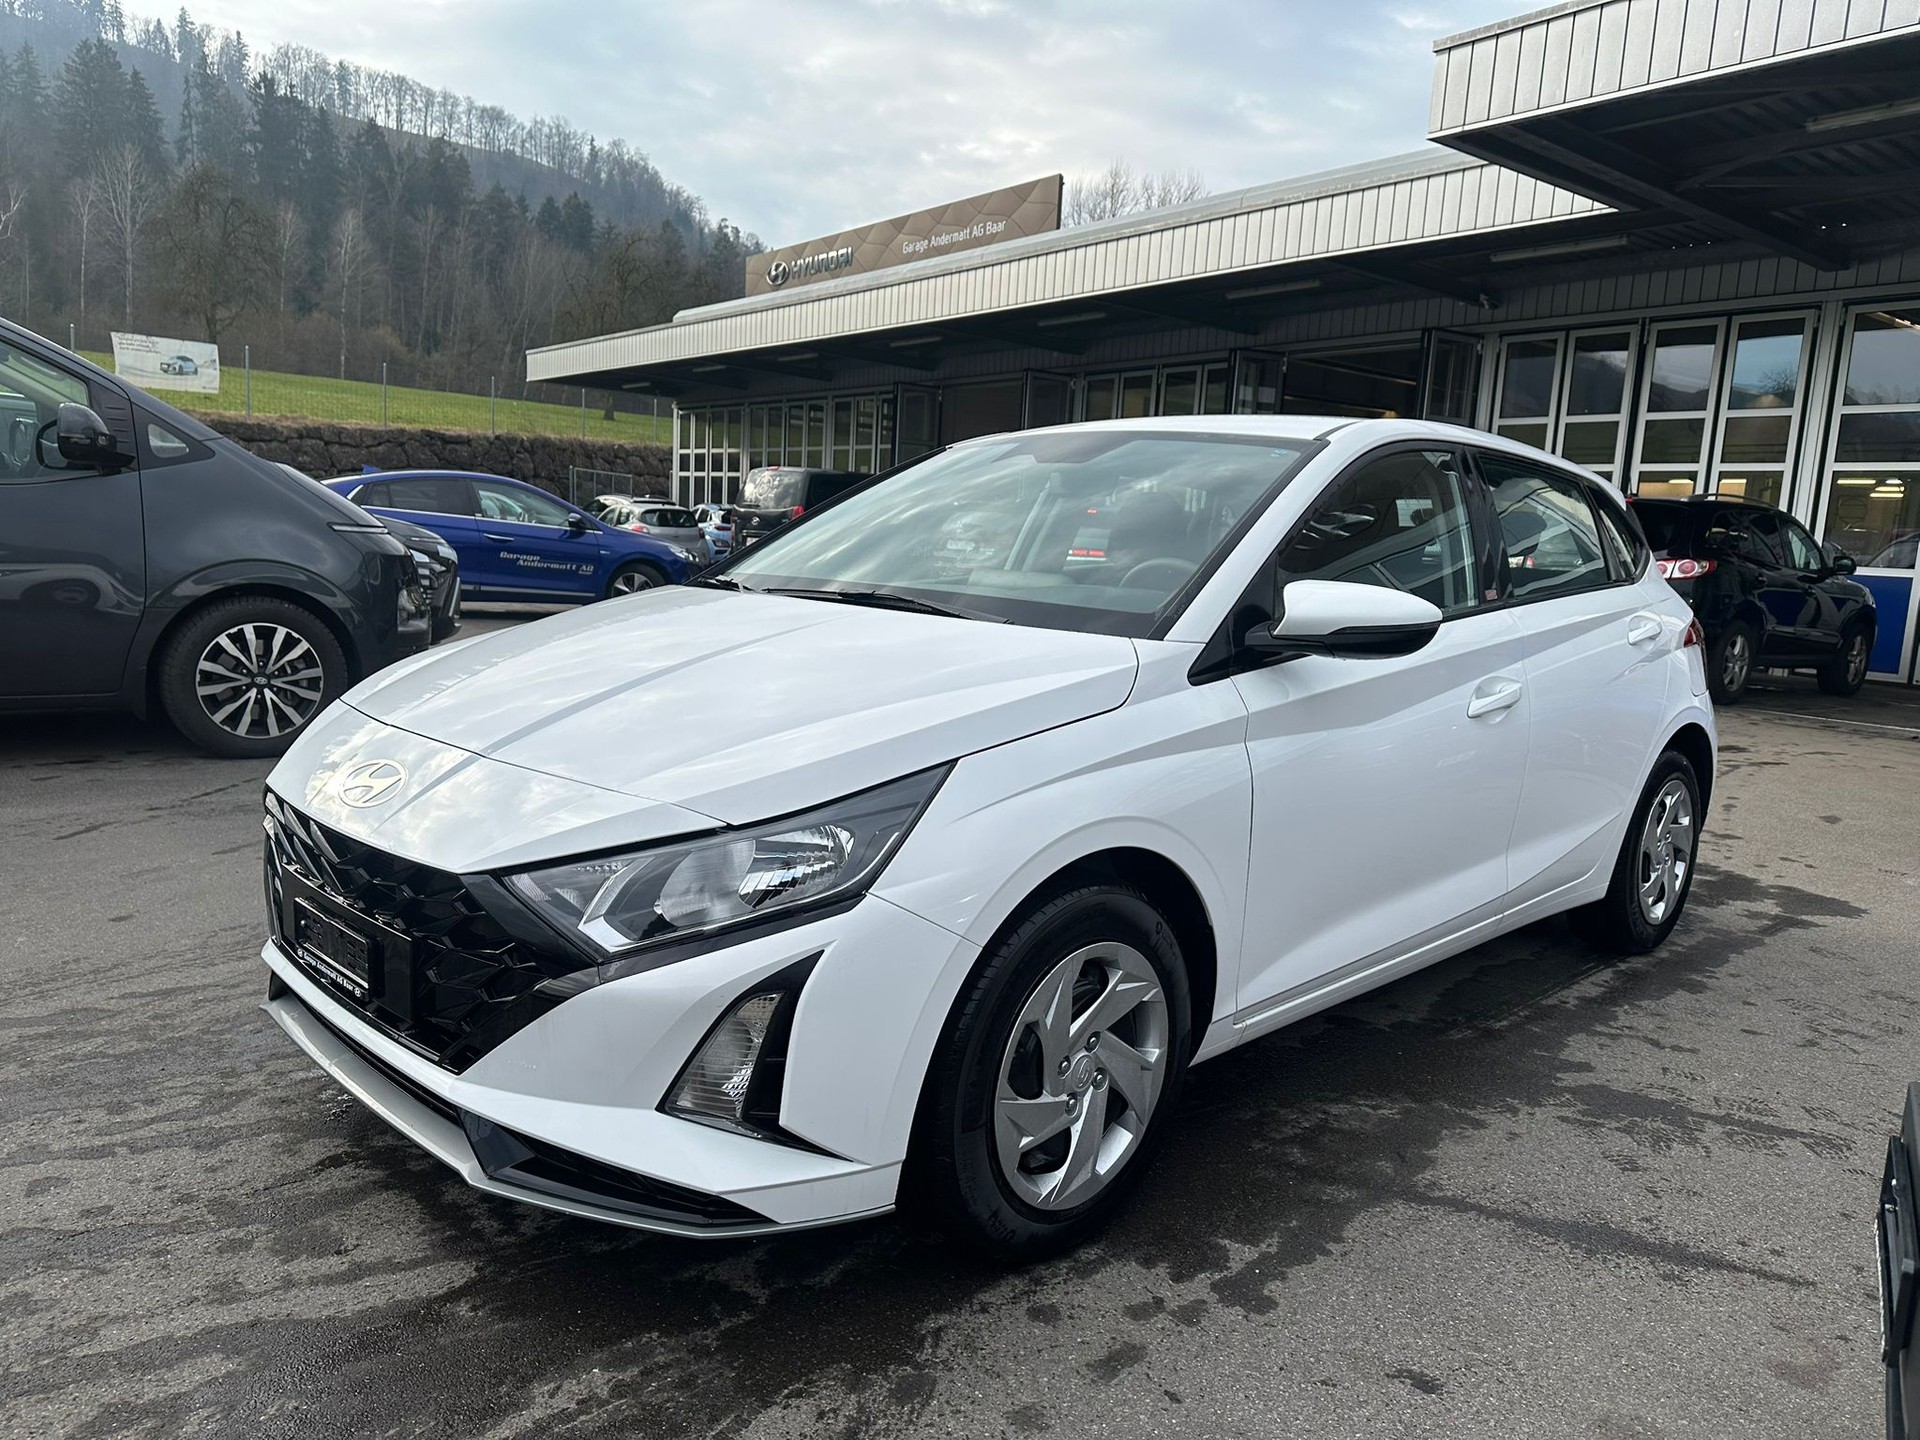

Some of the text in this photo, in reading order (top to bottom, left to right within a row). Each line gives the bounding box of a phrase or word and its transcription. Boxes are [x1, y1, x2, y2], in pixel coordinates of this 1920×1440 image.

[902, 221, 1007, 254] Garage Andermatt AG Baar
[791, 247, 853, 279] HYUNDAI
[500, 552, 540, 560] Garage
[517, 560, 577, 570] Andermatt
